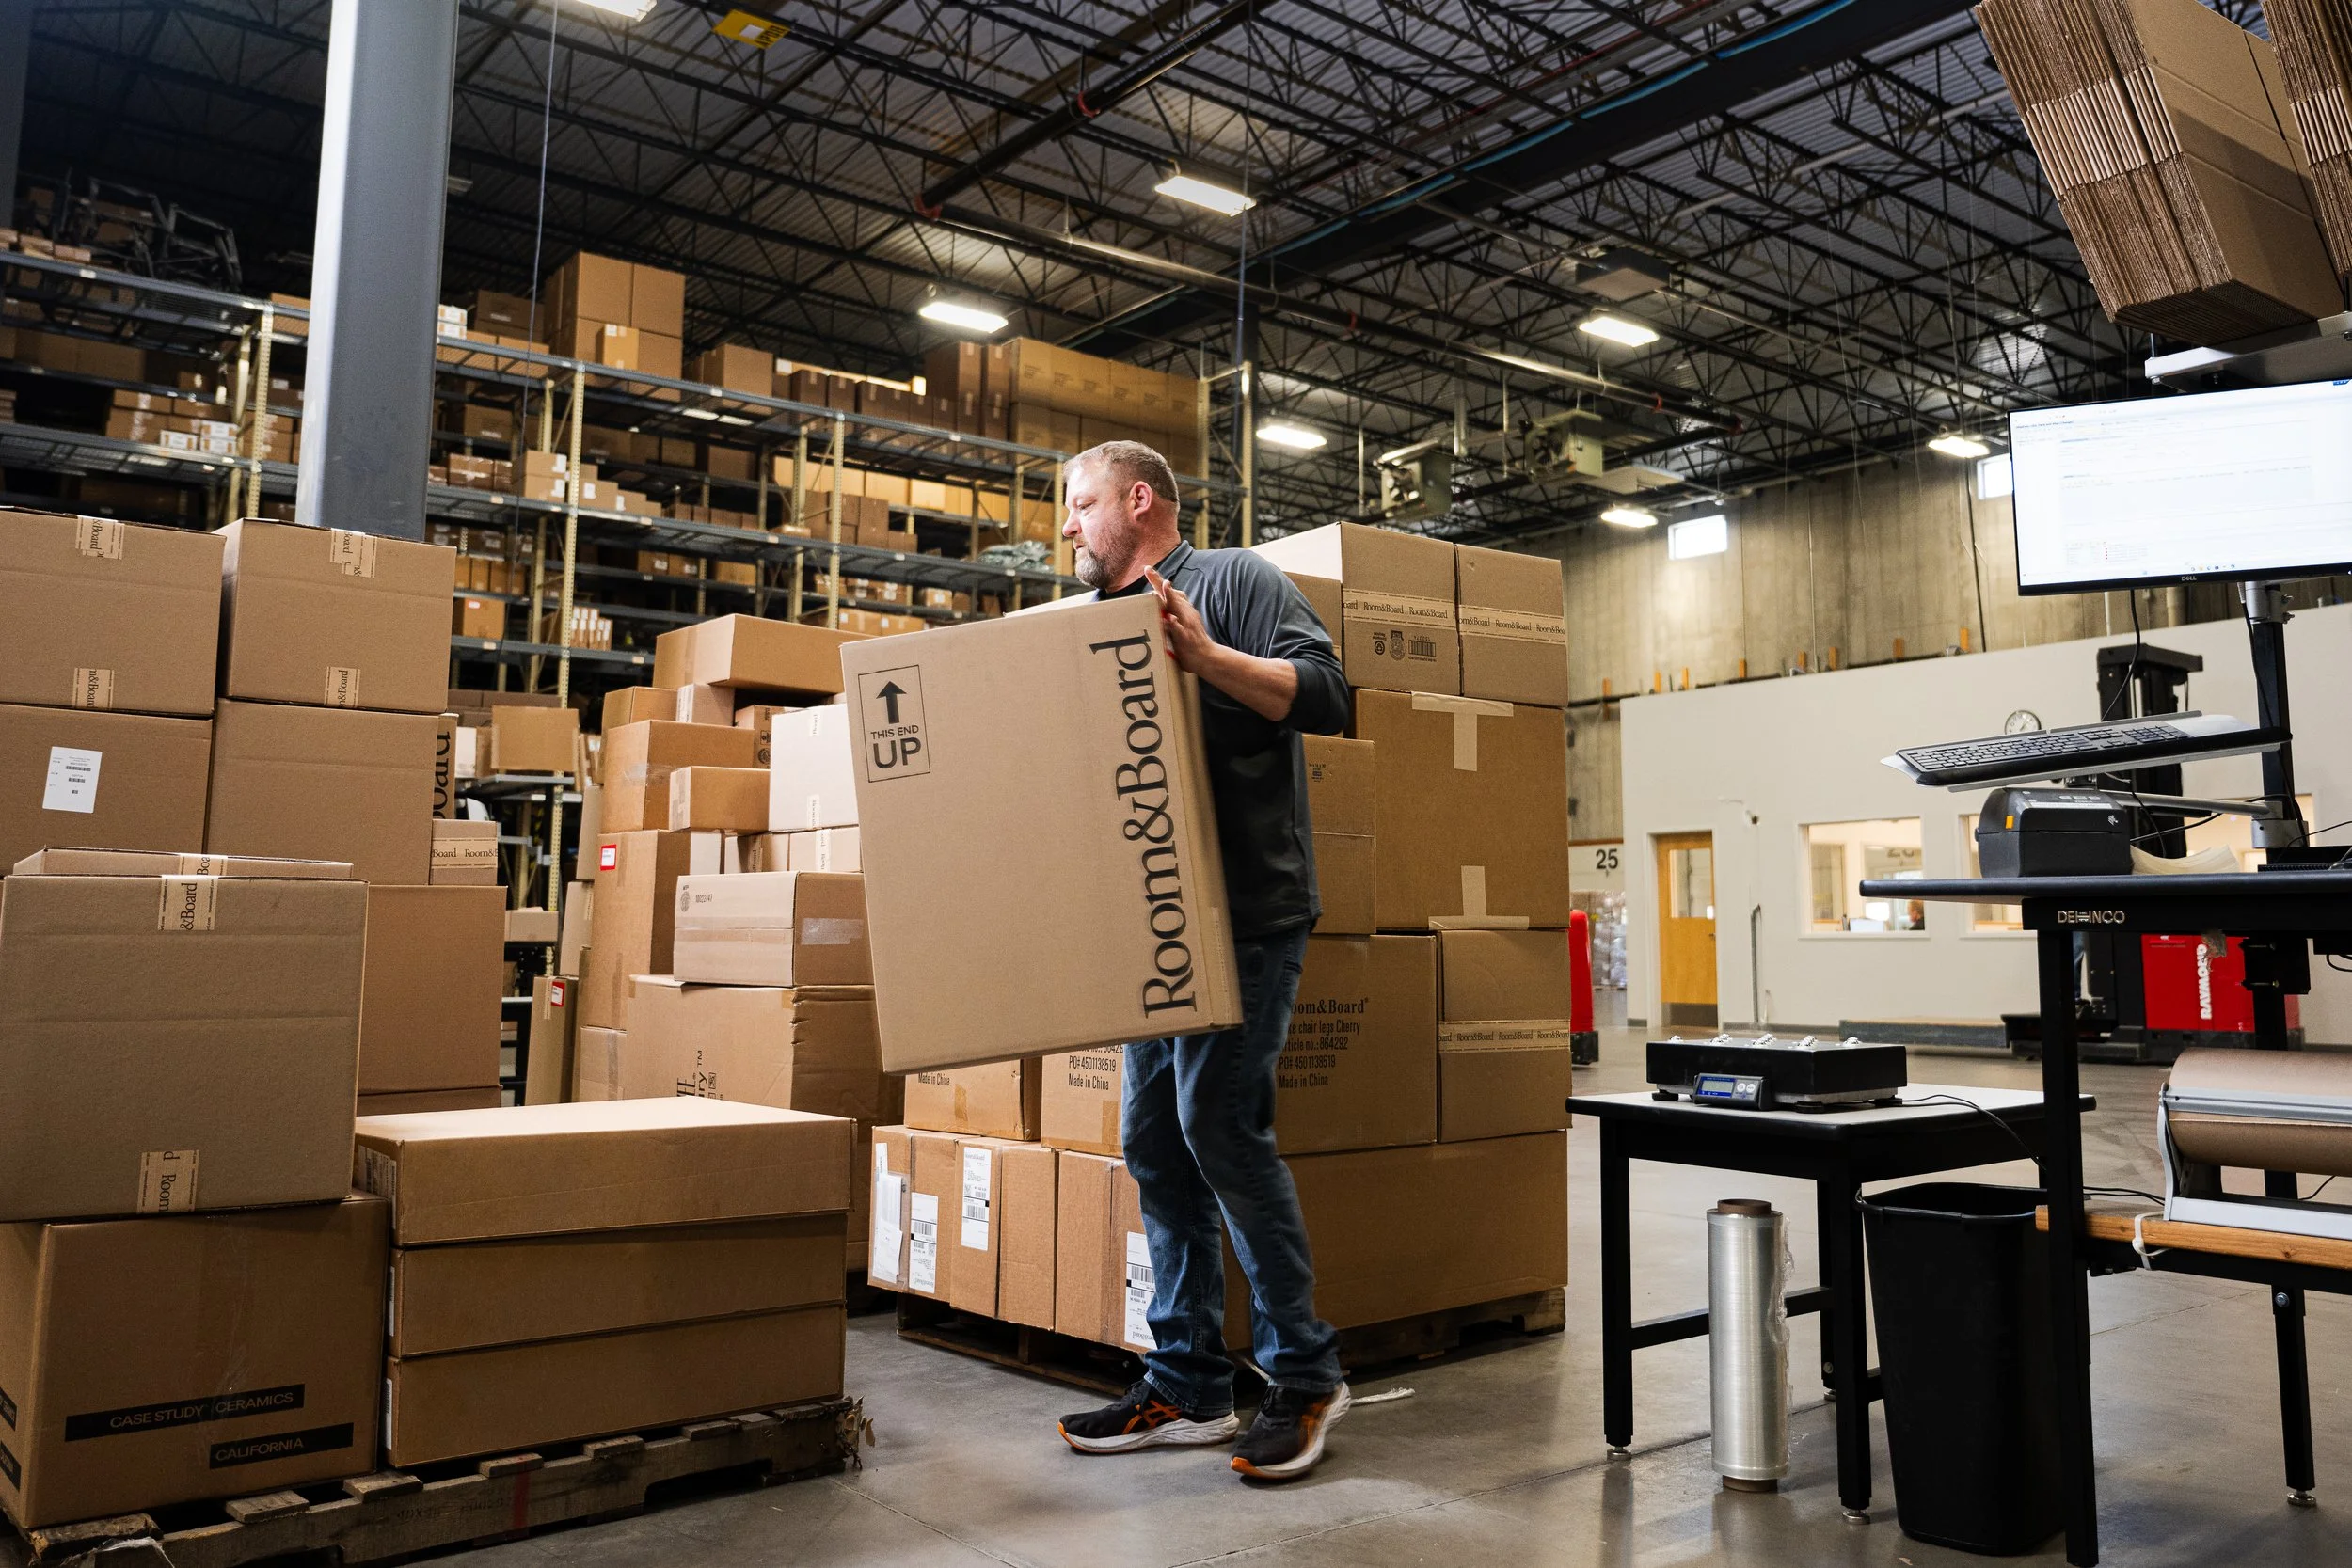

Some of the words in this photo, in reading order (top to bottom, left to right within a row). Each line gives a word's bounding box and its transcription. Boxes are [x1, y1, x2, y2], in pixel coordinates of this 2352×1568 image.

[1363, 602, 1404, 615] Room&Board
[1409, 606, 1448, 619] Room&Board
[1495, 619, 1532, 631] Room&Board
[870, 729, 895, 740] THIS
[897, 724, 919, 736] END
[873, 737, 921, 769] UP
[1089, 628, 1198, 1019] Room&Board
[1596, 848, 1618, 870] 25
[180, 882, 198, 930] &Board
[2196, 943, 2212, 1020] RAYMOND
[1298, 1021, 1317, 1034] chair
[1319, 1020, 1334, 1036] legs
[1336, 1019, 1360, 1036] Cherry
[1284, 1037, 1304, 1052] rticle
[918, 1071, 930, 1084] Made
[936, 1072, 950, 1086] China
[1068, 1072, 1083, 1087] Made
[1085, 1074, 1091, 1089] in
[1092, 1075, 1109, 1091] China
[1279, 1074, 1298, 1089] Made
[1300, 1074, 1307, 1088] in
[1309, 1072, 1328, 1087] China
[109, 1413, 152, 1430] CASE
[153, 1405, 204, 1423] STUDY
[214, 1391, 294, 1414] CERAMICS
[215, 1436, 305, 1463] CALIFORNIA
